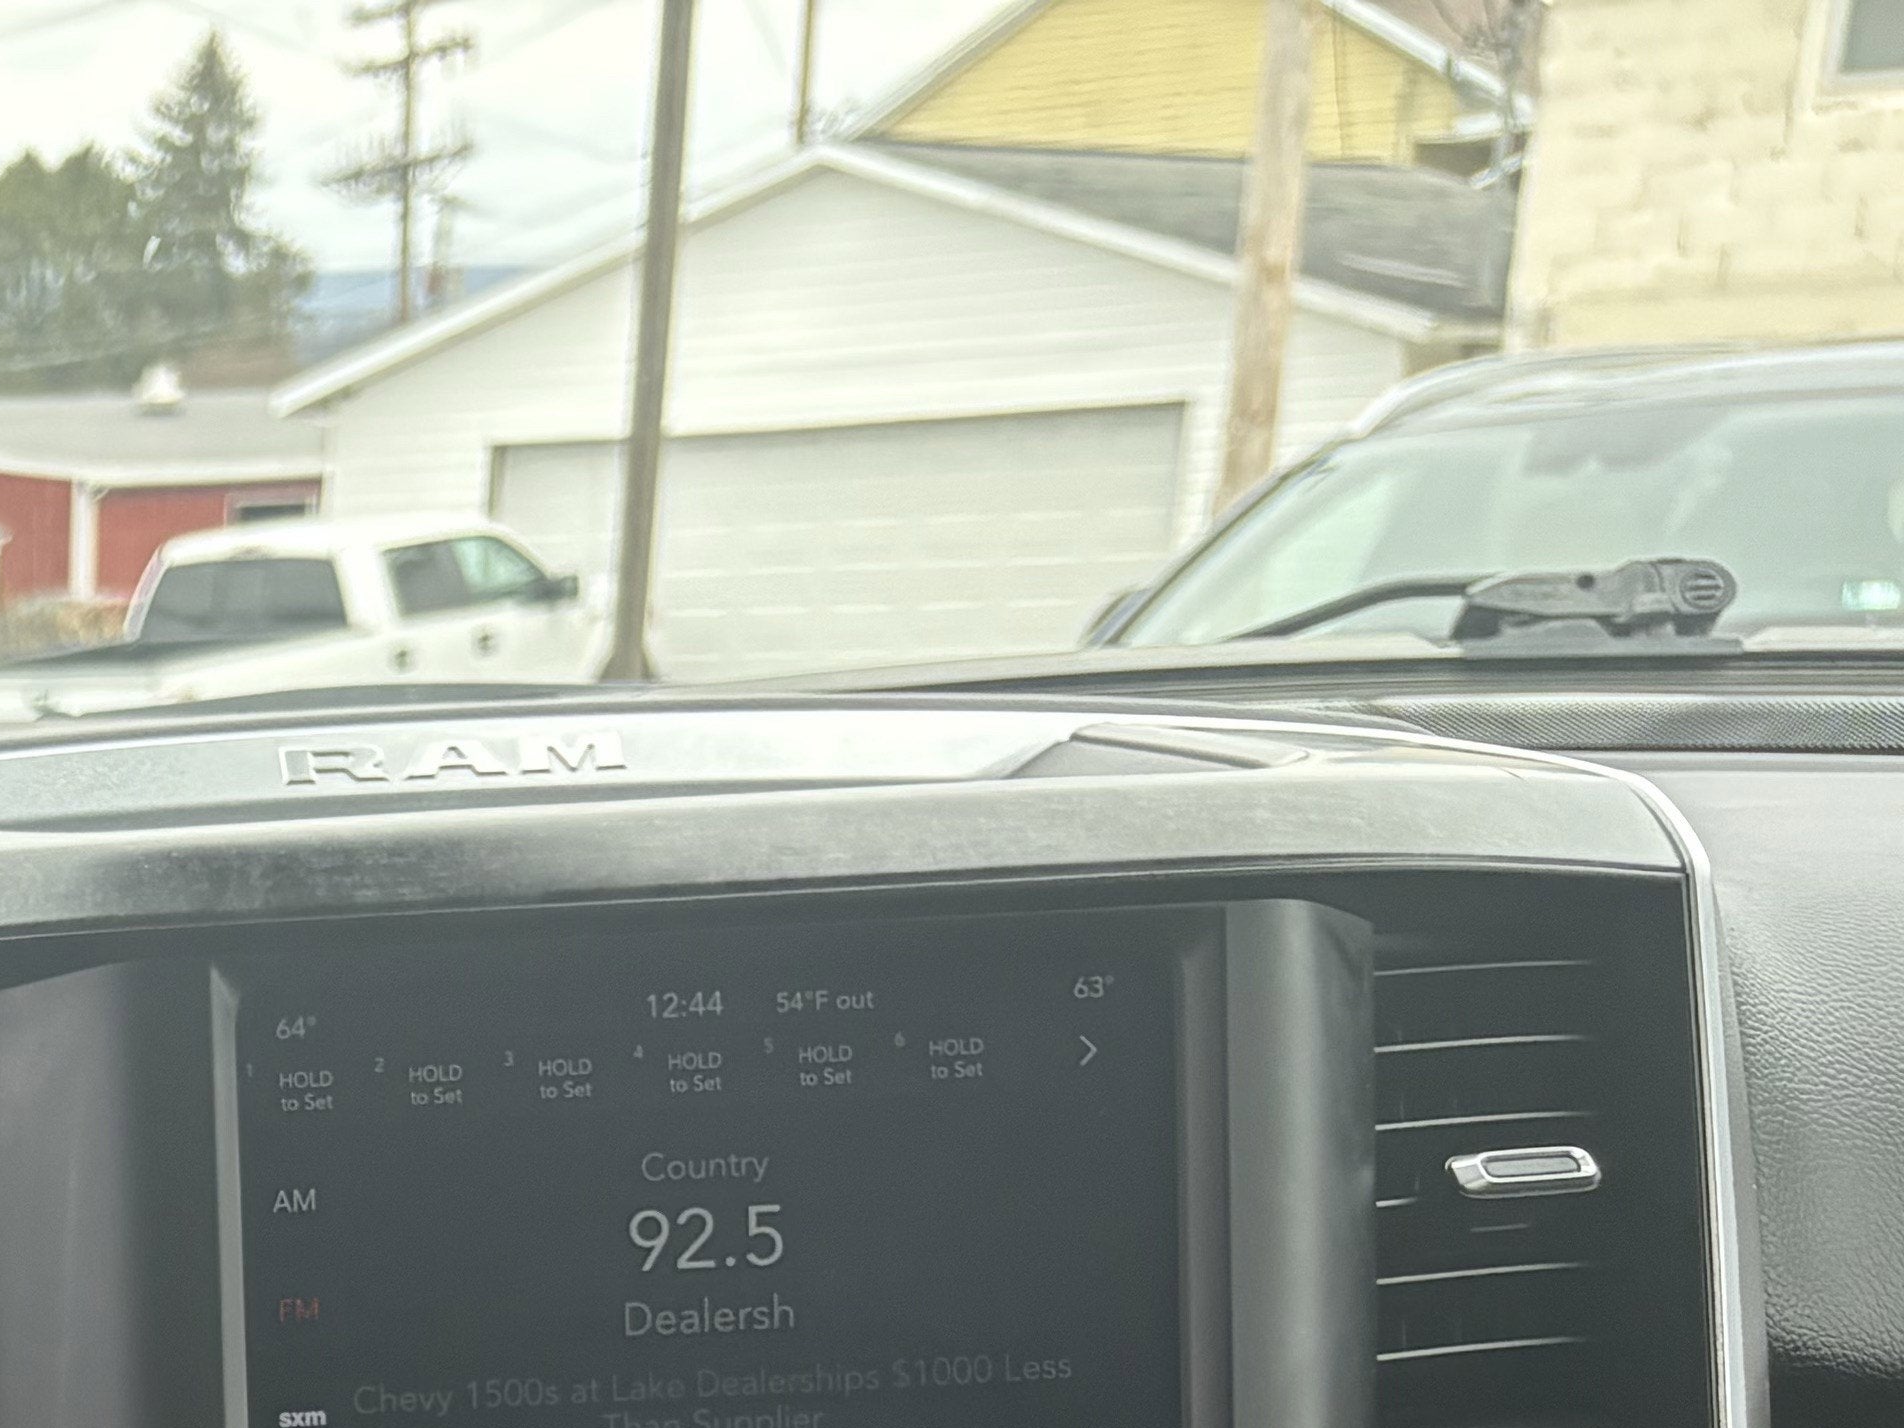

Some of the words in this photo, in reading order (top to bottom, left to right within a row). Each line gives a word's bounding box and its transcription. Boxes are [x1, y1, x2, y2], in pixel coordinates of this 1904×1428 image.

[278, 728, 627, 785] RAM
[1073, 975, 1116, 999] 63°
[646, 991, 724, 1019] 12:44
[777, 991, 828, 1013] 54°F
[836, 991, 874, 1010] out
[276, 1015, 316, 1039] 64°
[929, 1038, 984, 1056] HOLD
[279, 1071, 333, 1089] HOLD
[931, 1064, 948, 1079] to
[954, 1061, 983, 1078] Set
[281, 1096, 298, 1111] to
[304, 1094, 333, 1110] Set
[641, 1151, 769, 1184] Country
[272, 1189, 317, 1214] AM
[628, 1206, 784, 1272] 92.5
[279, 1299, 320, 1322] FM
[623, 1299, 795, 1337] Dealersh
[354, 1385, 453, 1417] Chevy
[467, 1378, 559, 1410] 1500s
[571, 1378, 600, 1402] at
[612, 1372, 686, 1401] Lake
[697, 1364, 880, 1397] Dealerships
[893, 1355, 992, 1388] $1000
[1005, 1355, 1072, 1382] Less
[279, 1410, 327, 1428] sxm
